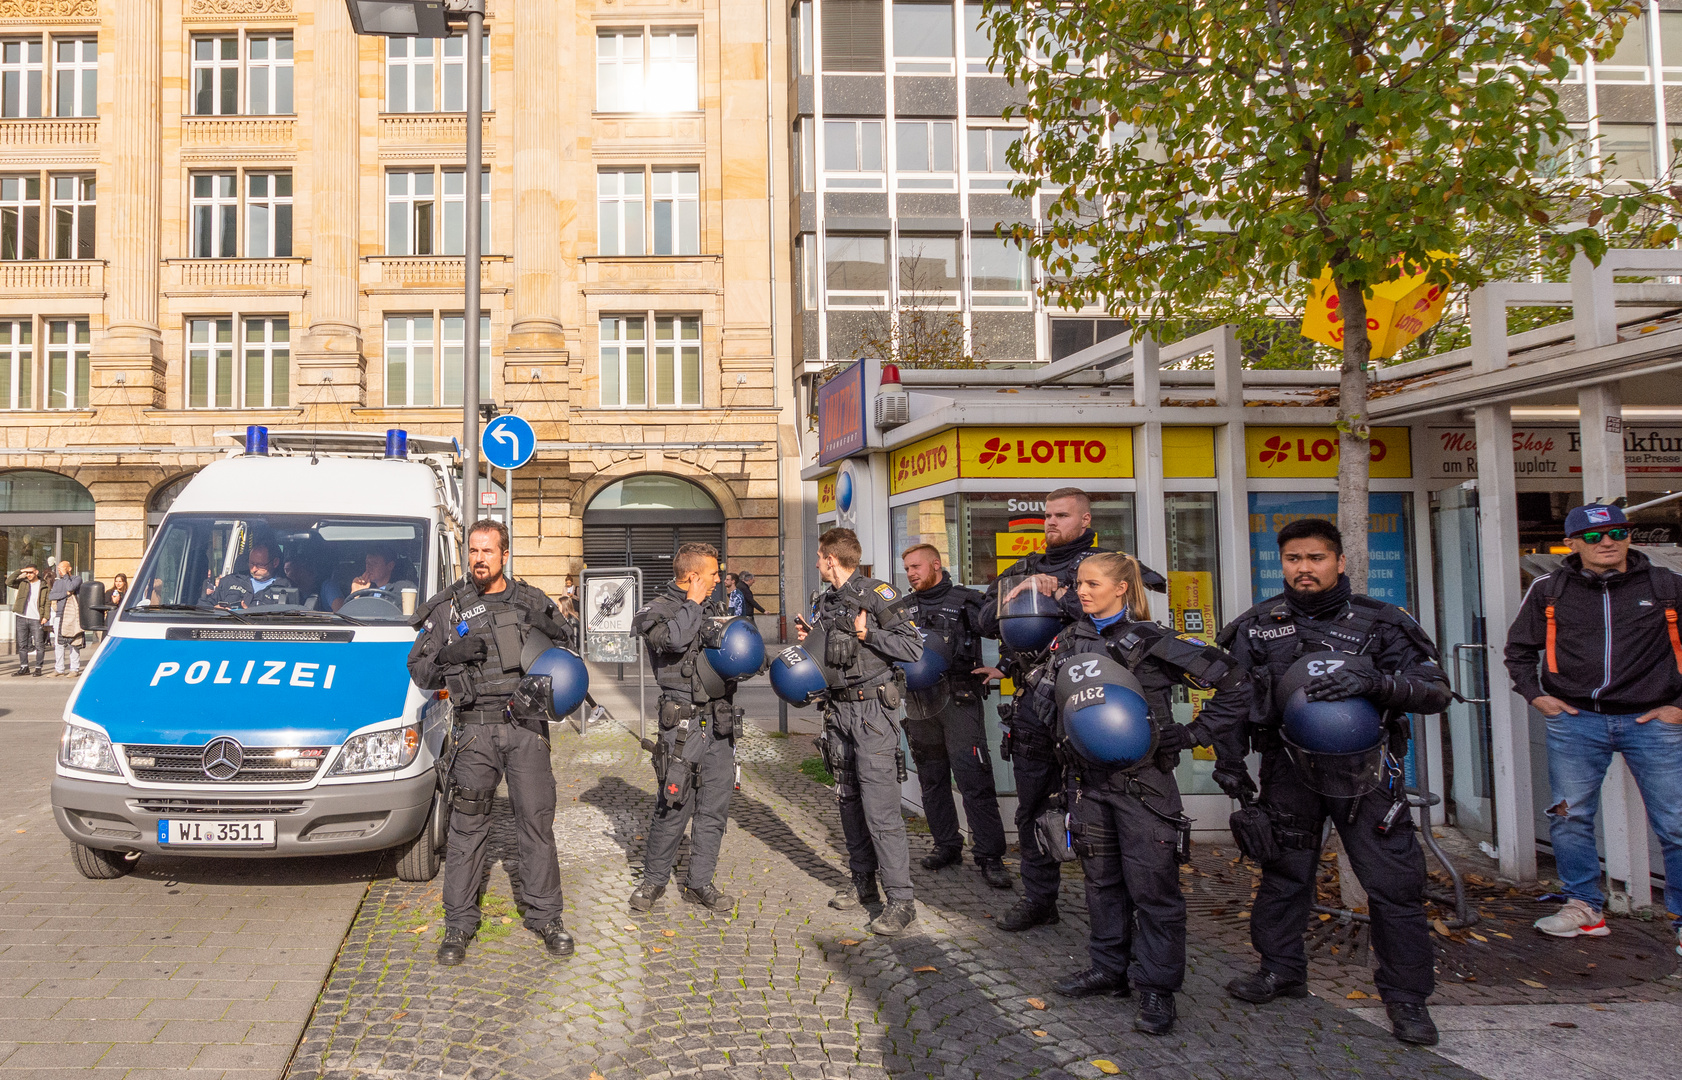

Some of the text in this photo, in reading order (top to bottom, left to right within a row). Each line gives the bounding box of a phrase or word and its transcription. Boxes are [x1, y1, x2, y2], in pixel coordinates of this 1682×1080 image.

[1328, 317, 1380, 343] LOO
[1395, 314, 1424, 335] LOTTO
[820, 371, 861, 454] journal
[1017, 439, 1107, 464] LOTTO
[1298, 438, 1387, 462] LOO
[1512, 432, 1555, 455] Shop
[911, 444, 948, 477] LOTTO
[1442, 461, 1463, 473] am
[1643, 453, 1681, 464] Presse
[1259, 551, 1275, 561] MIT
[1368, 550, 1400, 561] ÖGLICH
[1368, 588, 1386, 597] .000
[461, 604, 487, 621] POLIZEI
[1203, 604, 1215, 640] JACKPOT
[1262, 624, 1297, 641] POLIZEI
[150, 660, 337, 689] POLIZEI
[1068, 659, 1102, 683] 23
[1307, 659, 1345, 677] 23
[1071, 686, 1105, 706] 2314
[301, 749, 323, 757] CDI
[179, 823, 264, 841] WI 3511
